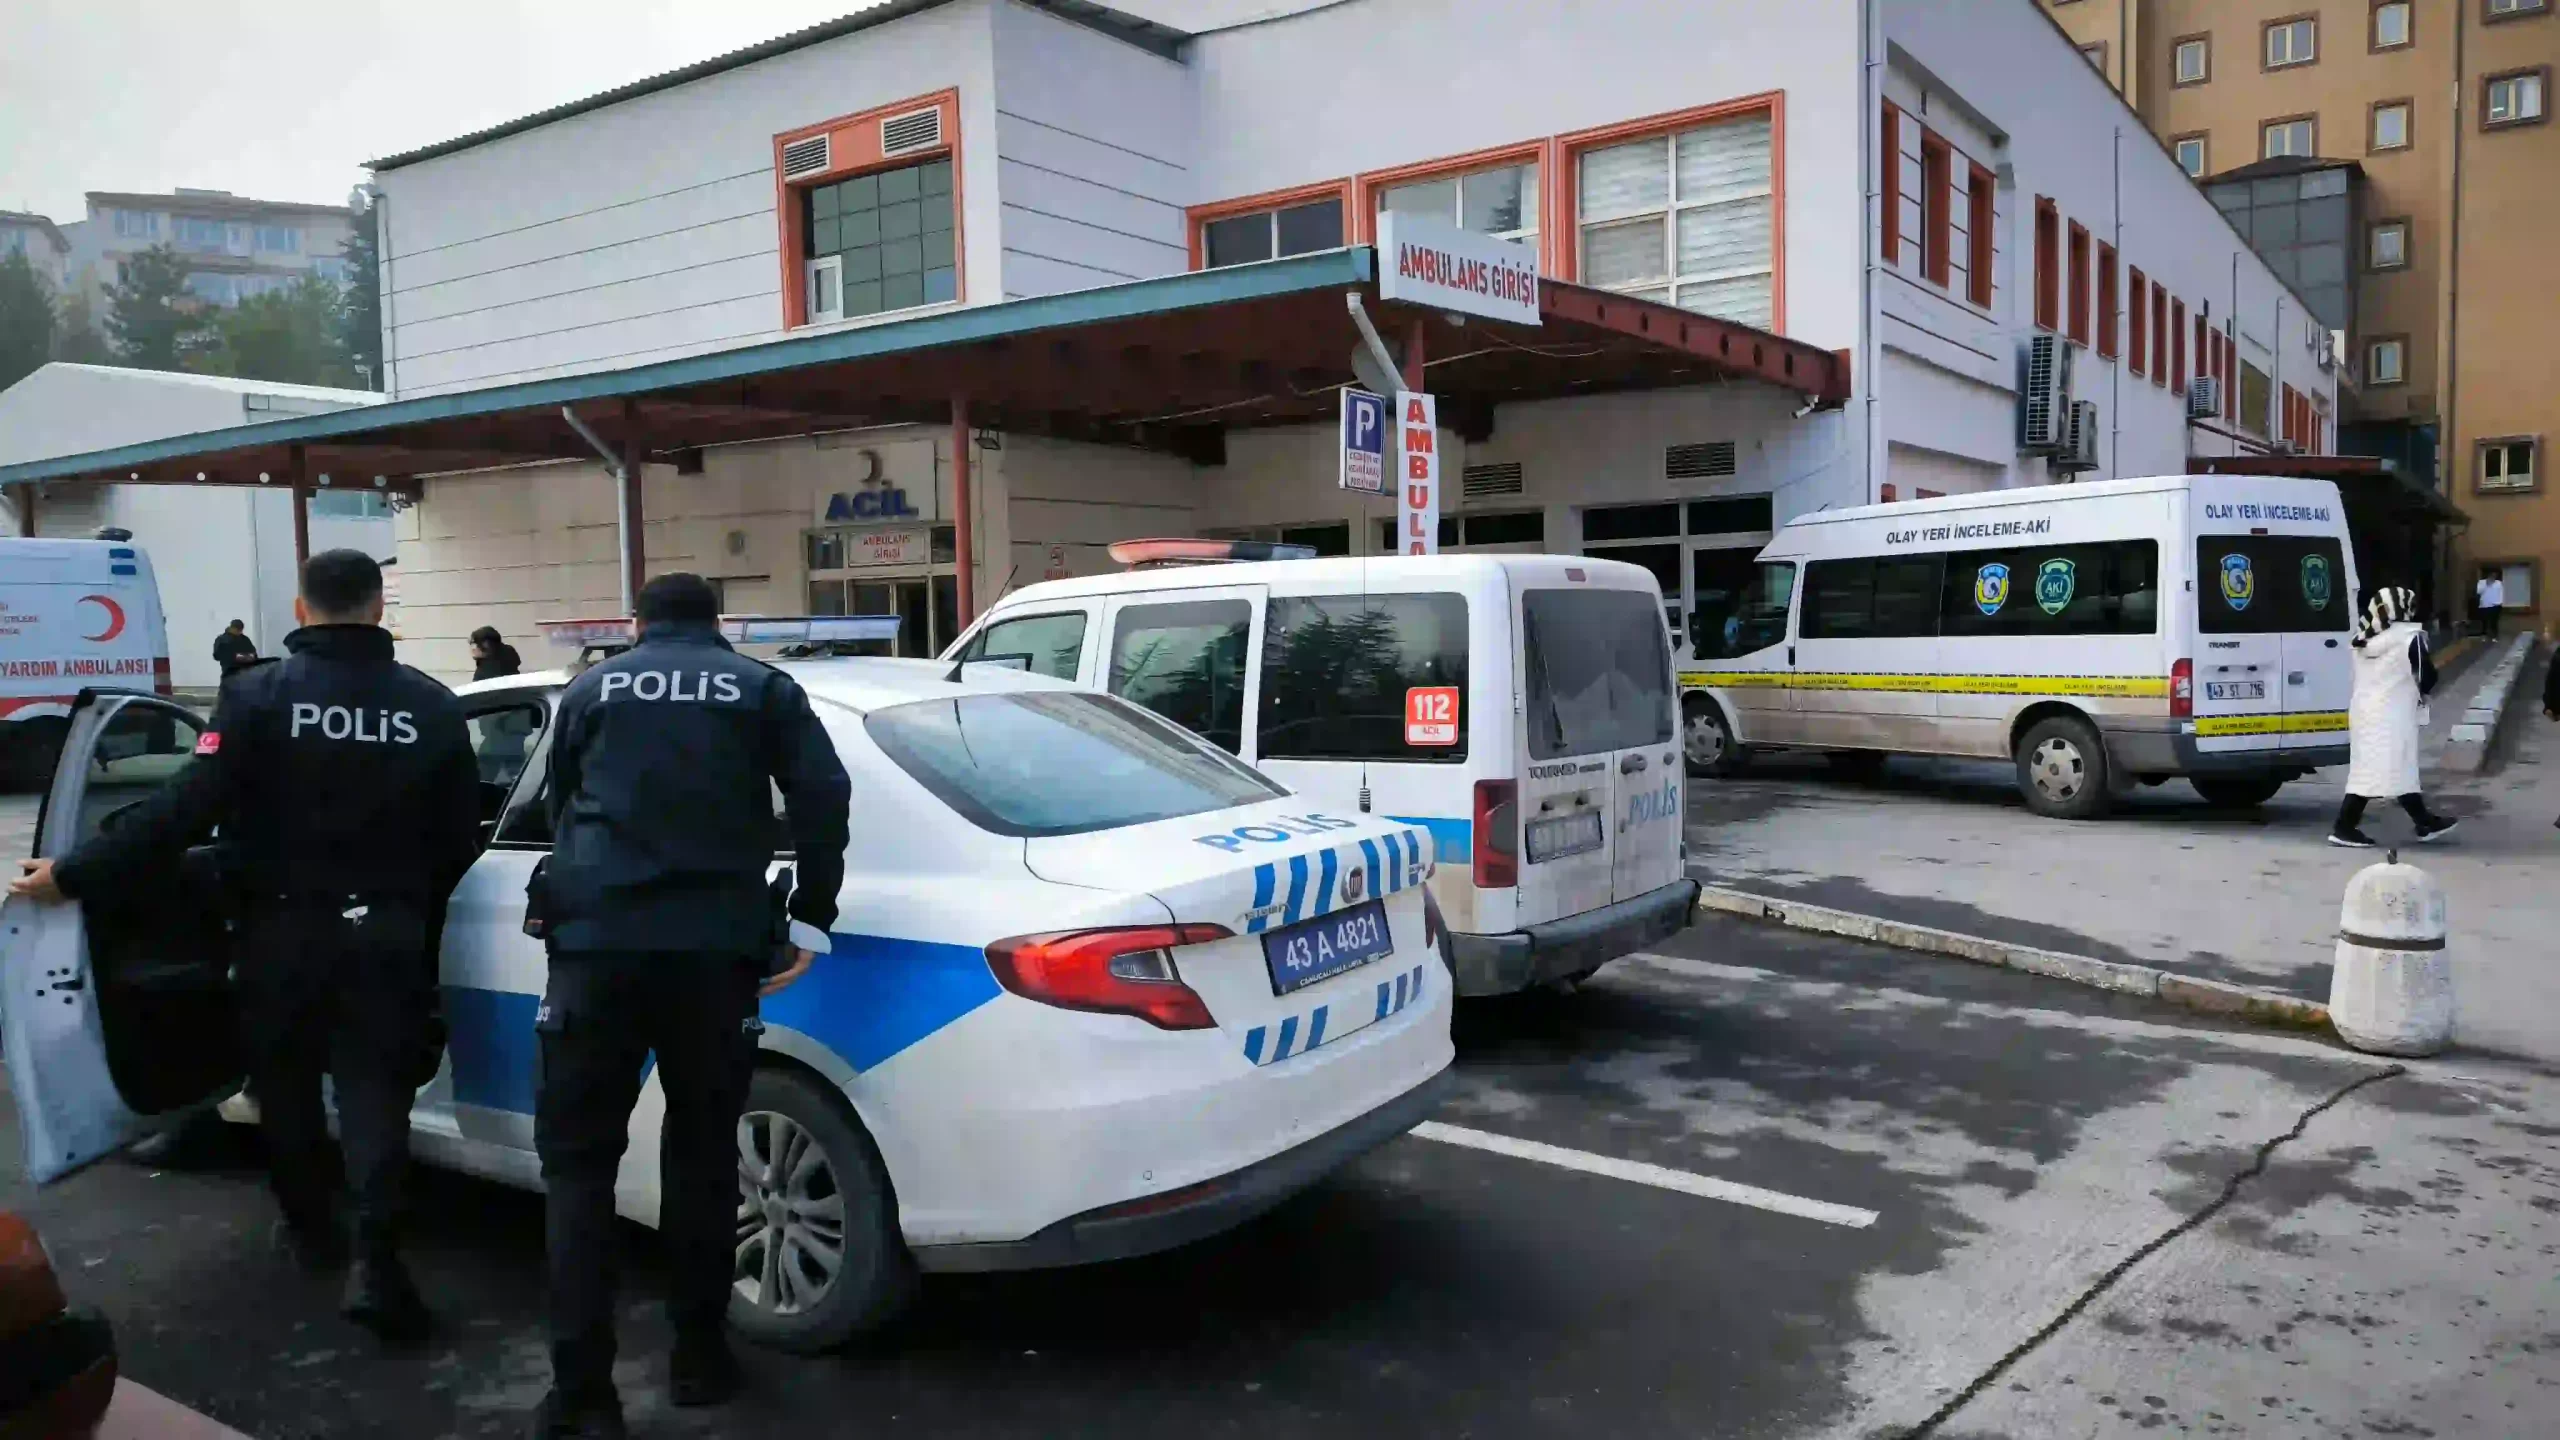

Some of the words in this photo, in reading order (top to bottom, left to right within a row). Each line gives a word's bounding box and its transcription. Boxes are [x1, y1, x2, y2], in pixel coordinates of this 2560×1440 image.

[1400, 242, 1488, 295] AMBULANS
[1492, 257, 1535, 308] GİRİŞİ
[1356, 401, 1375, 446] P
[1886, 530, 1918, 544] OLAY
[1922, 524, 1950, 541] YERİ
[1954, 516, 2050, 539] İNCELEME-AKİ
[2206, 504, 2233, 519] OLAY
[2238, 502, 2261, 519] YERİ
[2045, 581, 2063, 594] AKİ
[600, 670, 741, 702] POLİS
[291, 703, 418, 744] POLİS
[1414, 693, 1451, 720] 112
[1628, 777, 1678, 826] POLİS
[1192, 813, 1357, 853] POLİS
[1286, 937, 1312, 971] 43
[1318, 931, 1335, 963] A
[1337, 913, 1380, 952] 4821
